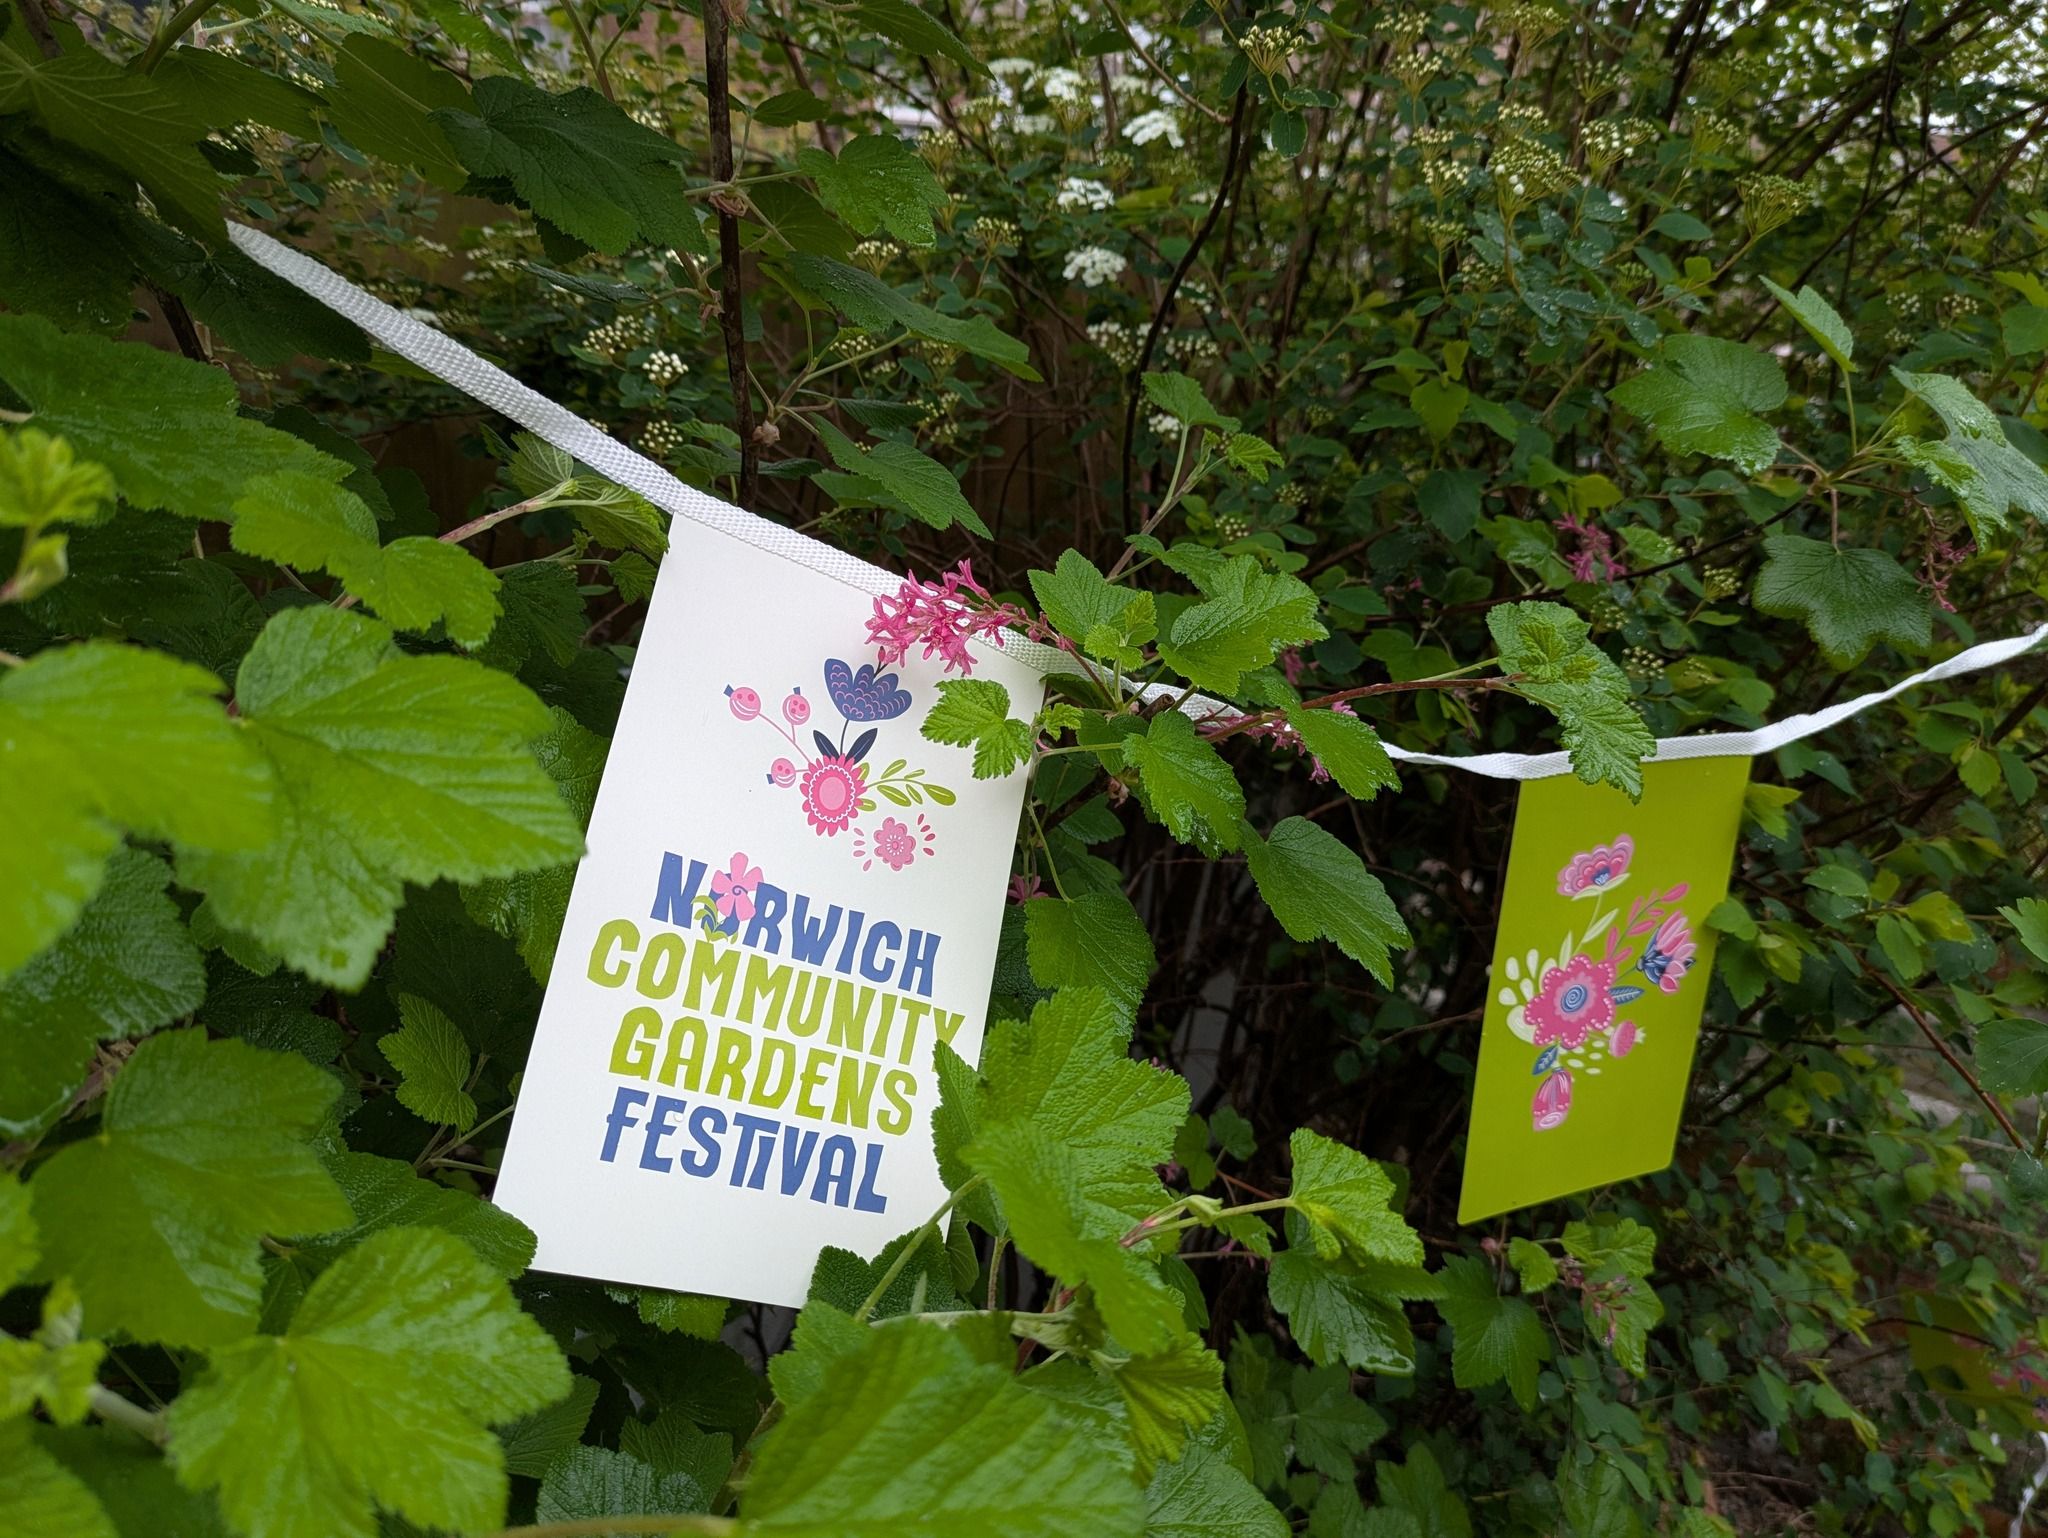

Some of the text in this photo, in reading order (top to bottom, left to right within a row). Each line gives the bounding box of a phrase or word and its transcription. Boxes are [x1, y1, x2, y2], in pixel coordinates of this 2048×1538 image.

[587, 918, 966, 1073] COMMUNITY
[608, 1006, 918, 1136] GARDENS
[599, 1086, 888, 1214] FESTIVAL
